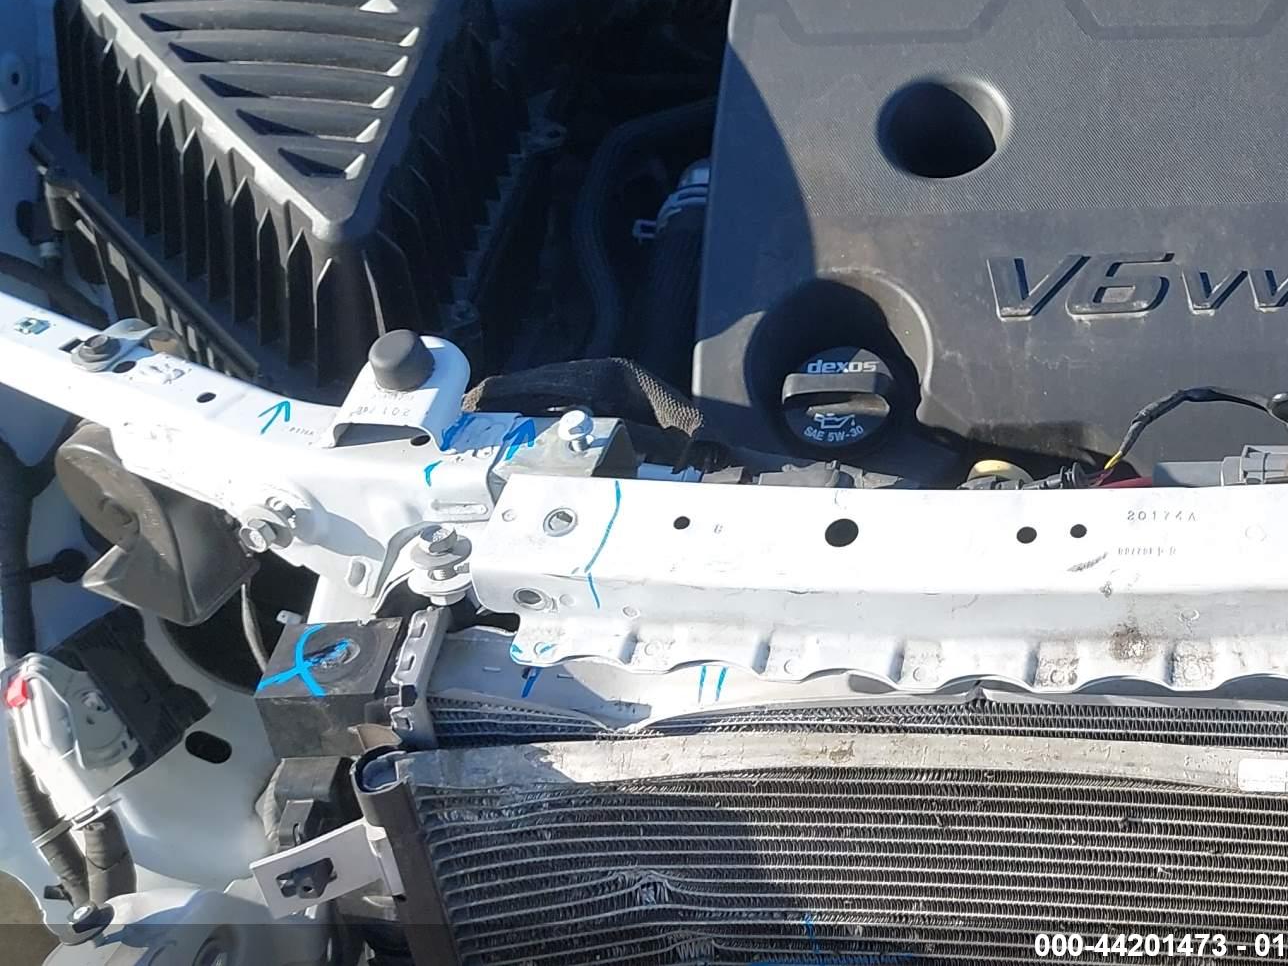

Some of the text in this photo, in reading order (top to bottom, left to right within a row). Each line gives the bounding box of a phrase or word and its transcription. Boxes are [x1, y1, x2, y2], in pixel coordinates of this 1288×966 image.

[986, 253, 1175, 321] V6
[807, 359, 880, 374] dexos
[803, 425, 865, 443] SAE 5W-30
